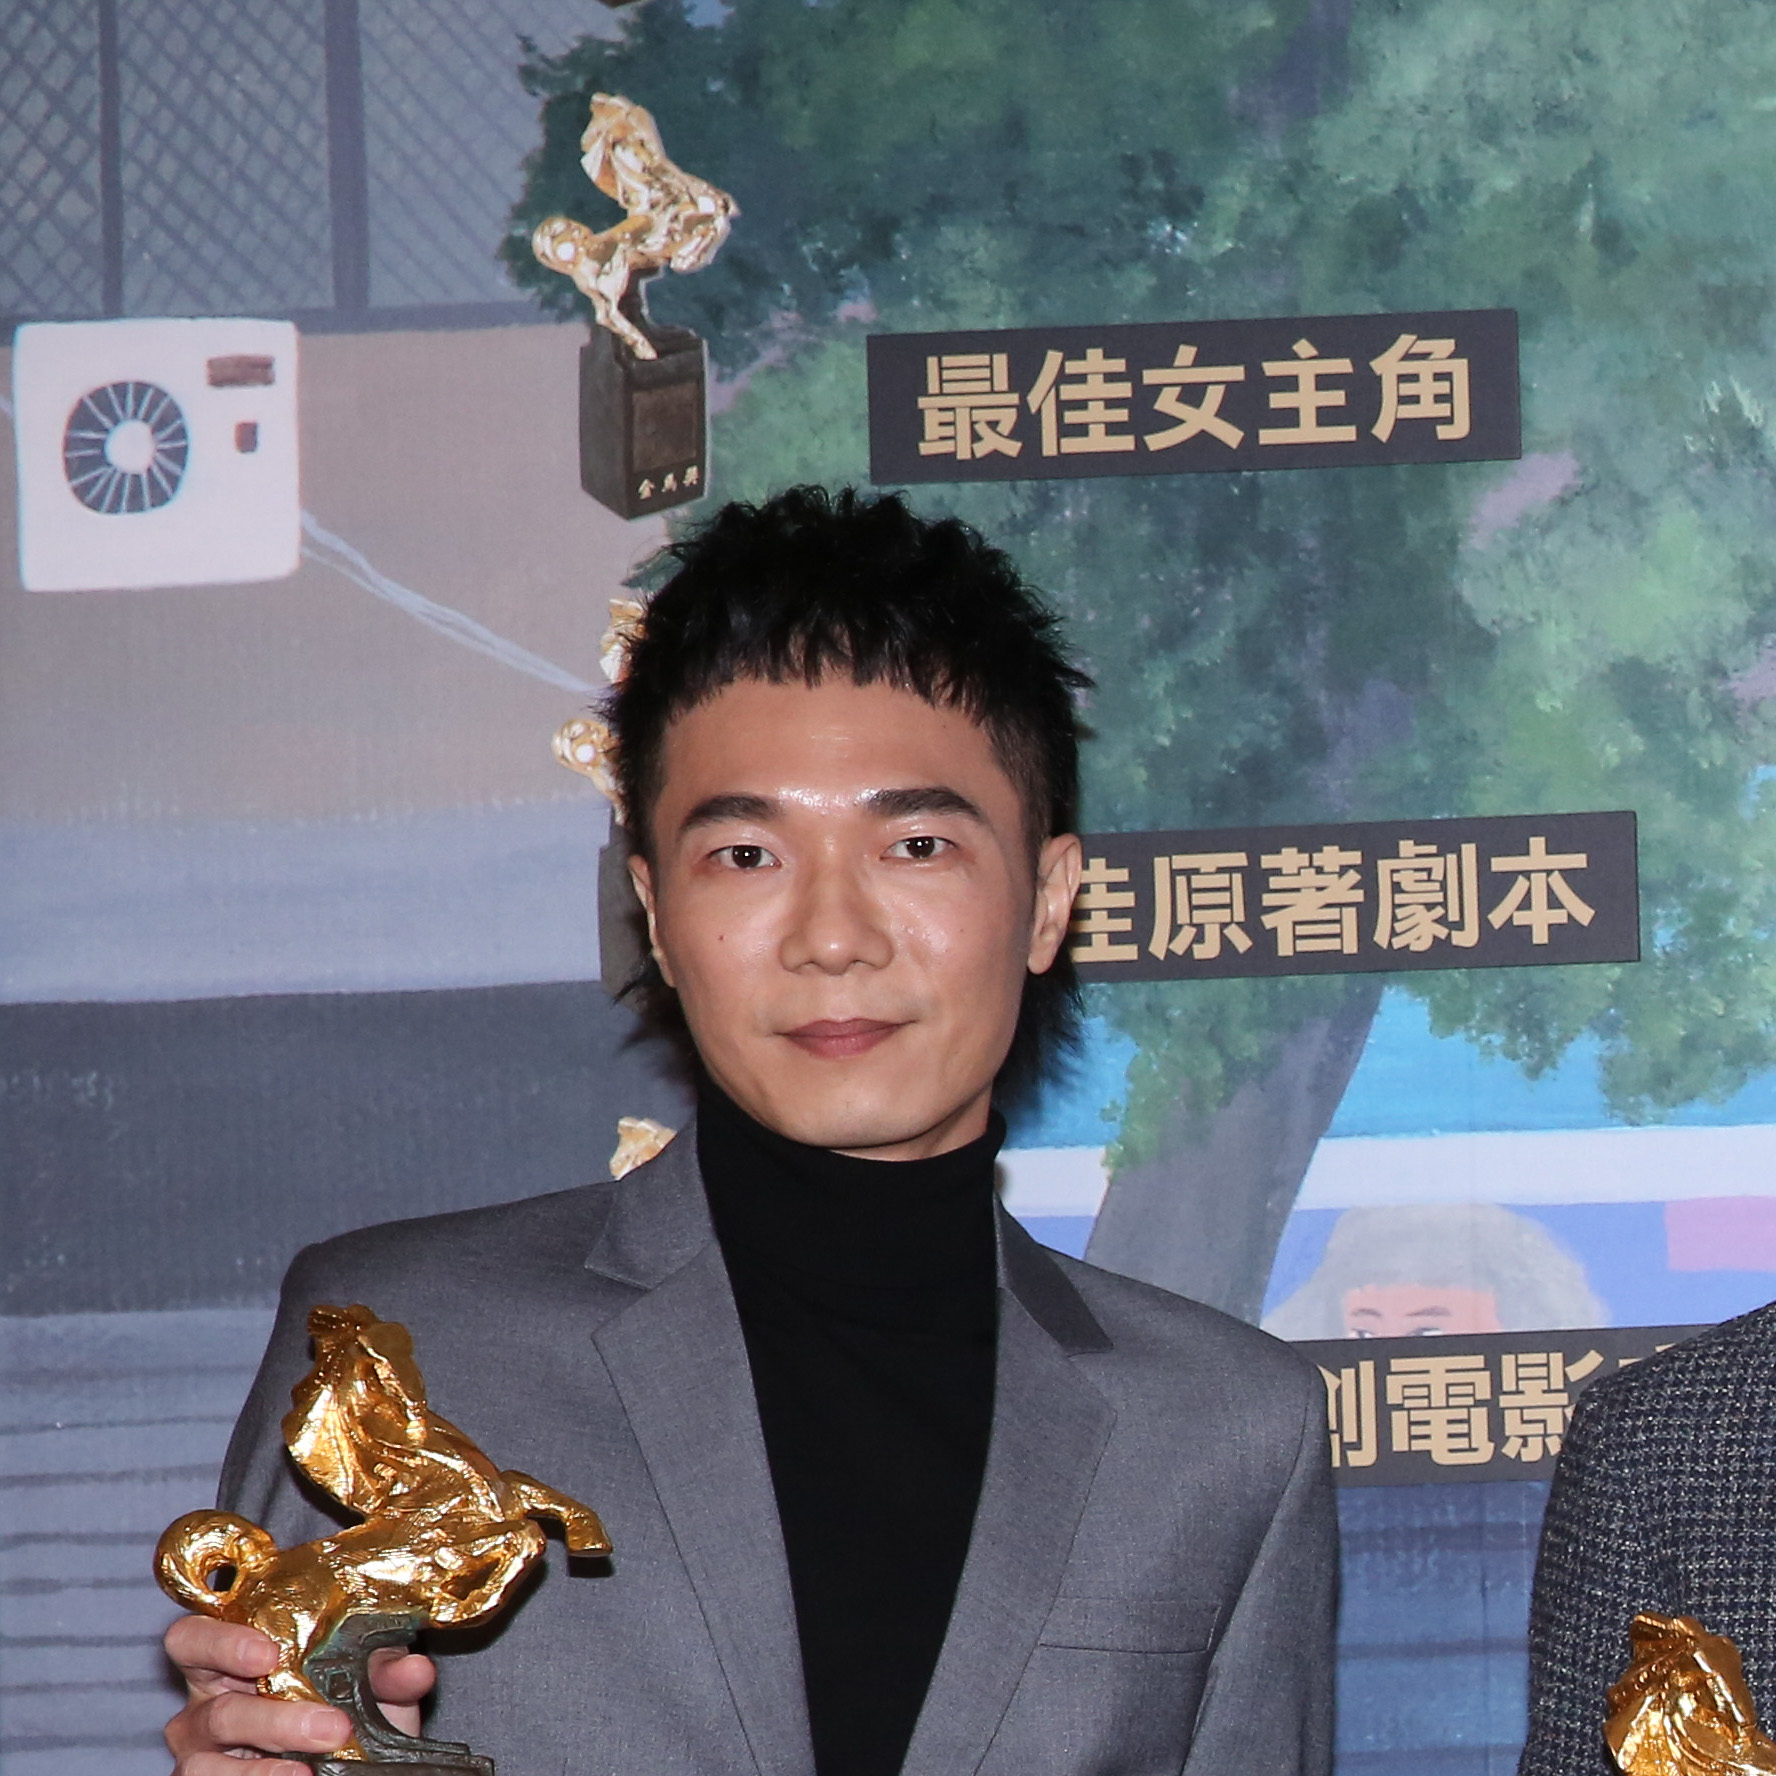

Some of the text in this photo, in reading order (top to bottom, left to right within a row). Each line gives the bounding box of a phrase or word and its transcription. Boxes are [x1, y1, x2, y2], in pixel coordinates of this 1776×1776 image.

[916, 334, 1473, 461] 最佳女主角
[1318, 1343, 1676, 1469] 電影
